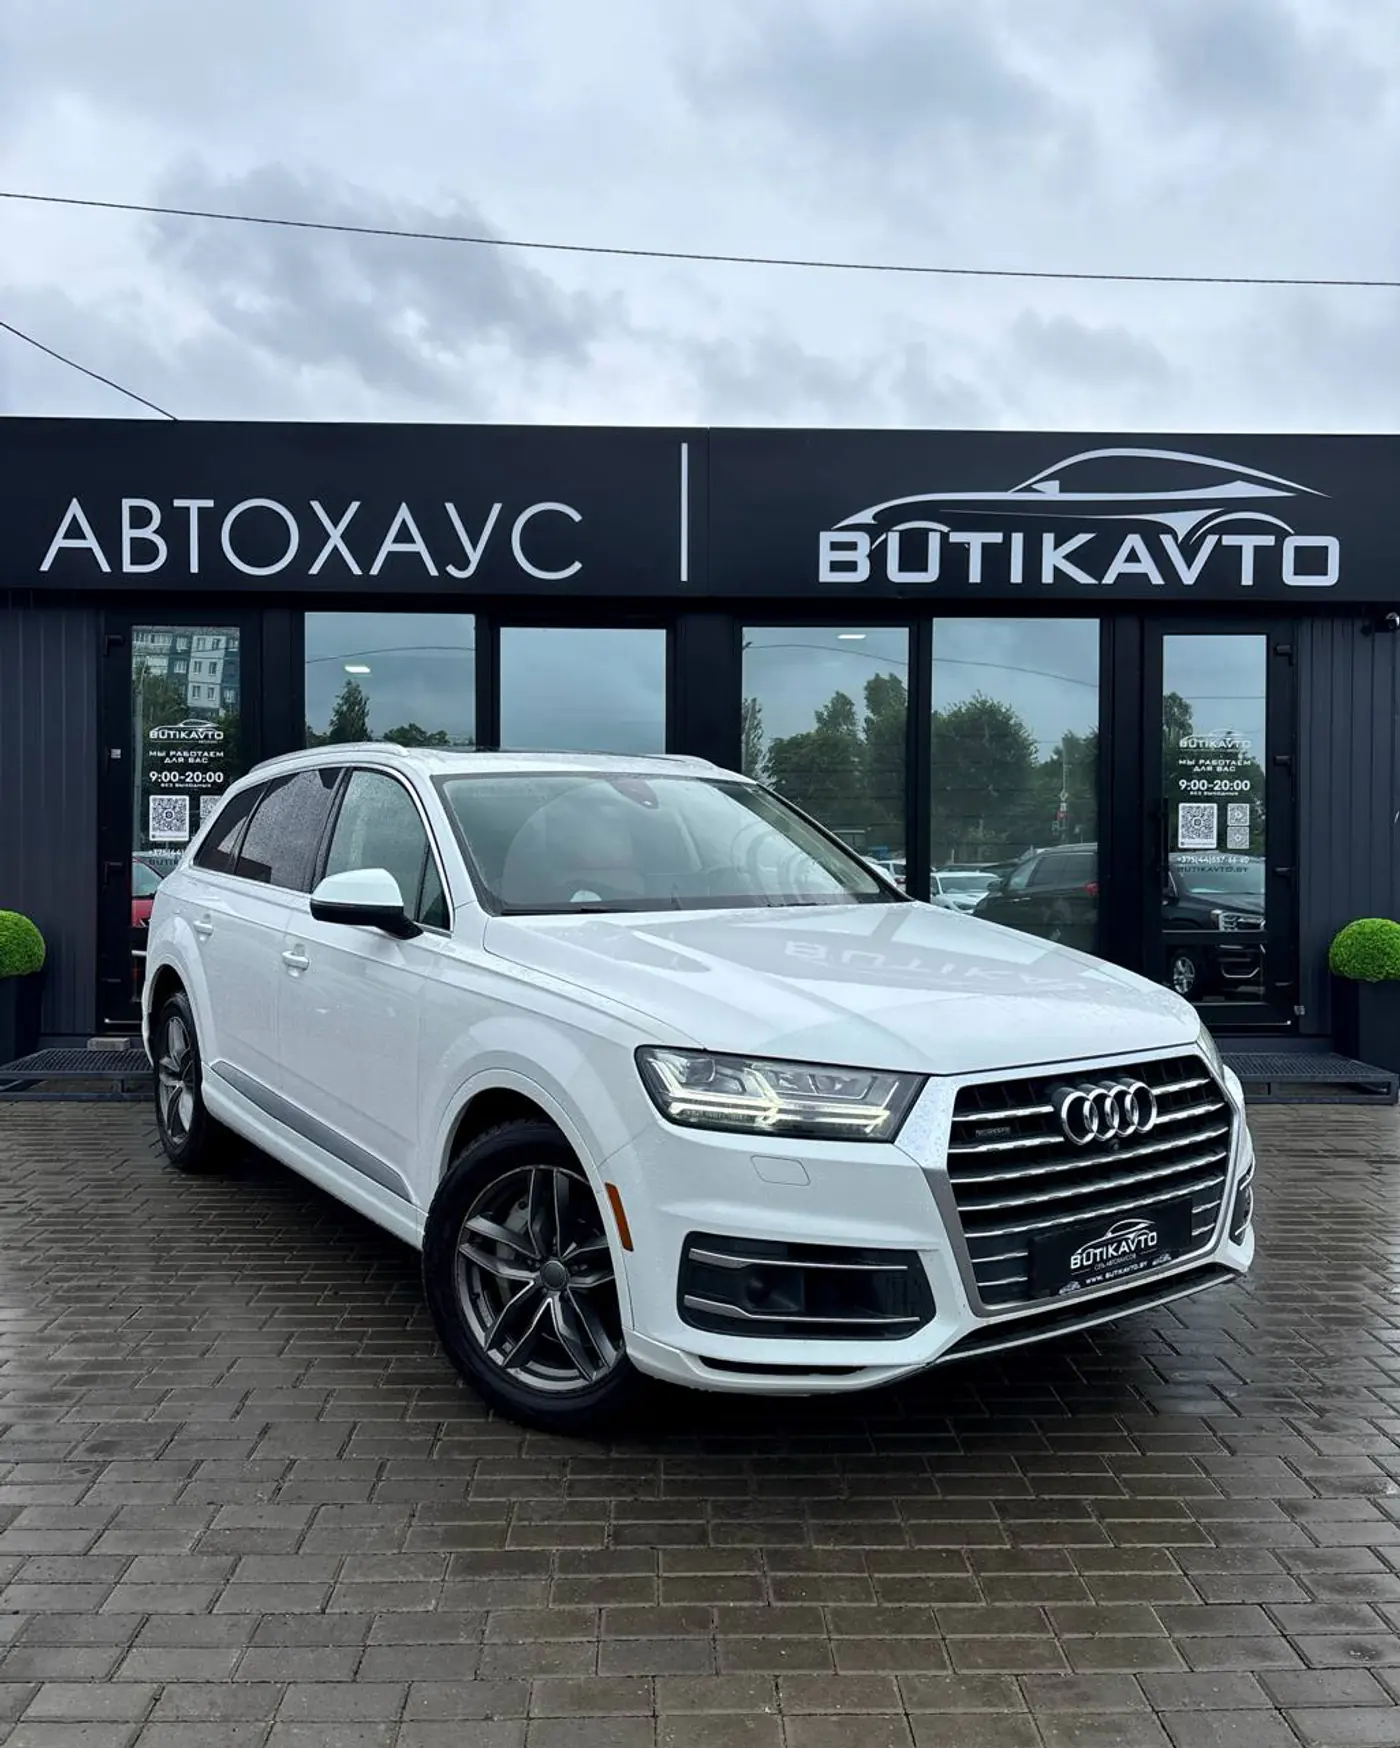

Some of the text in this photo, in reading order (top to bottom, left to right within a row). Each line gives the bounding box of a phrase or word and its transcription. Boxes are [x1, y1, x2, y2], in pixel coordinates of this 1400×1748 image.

[39, 497, 583, 580] АВТОХАУС
[818, 530, 1340, 587] BUTIKAVTO
[149, 730, 224, 740] BUTIKAVTO
[1179, 739, 1250, 748] BUTIKAVTO
[149, 771, 224, 783] 9:00-20:00
[1179, 779, 1250, 791] 9:00-20:00
[1070, 1231, 1157, 1269] BUTIKAVTO
